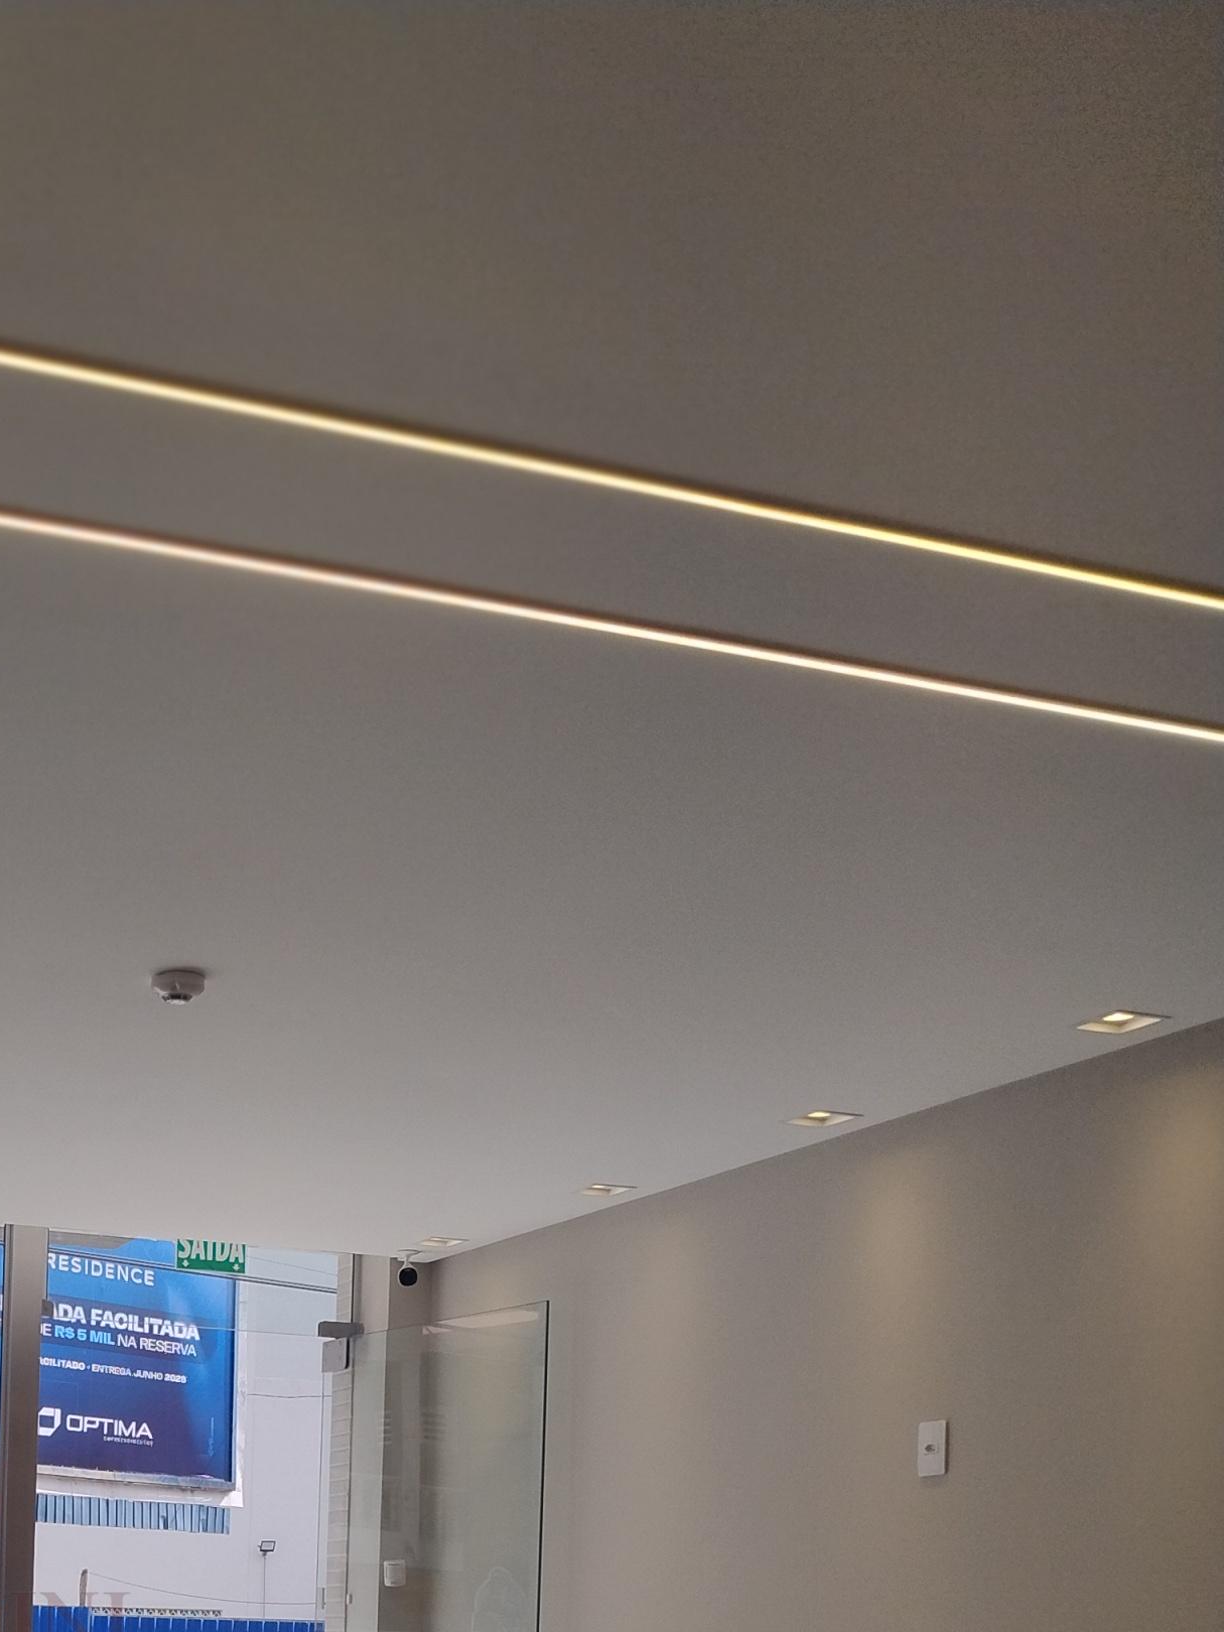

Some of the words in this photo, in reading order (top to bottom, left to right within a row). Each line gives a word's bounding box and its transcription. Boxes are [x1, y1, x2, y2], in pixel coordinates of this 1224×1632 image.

[54, 1324, 75, 1339] R$
[77, 1328, 87, 1341] 5
[89, 1330, 116, 1345] MIL
[117, 1333, 137, 1349] NA
[139, 1337, 197, 1357] RESERVA
[90, 1308, 200, 1341] FACILITADA
[66, 1414, 154, 1440] OPTIMA
